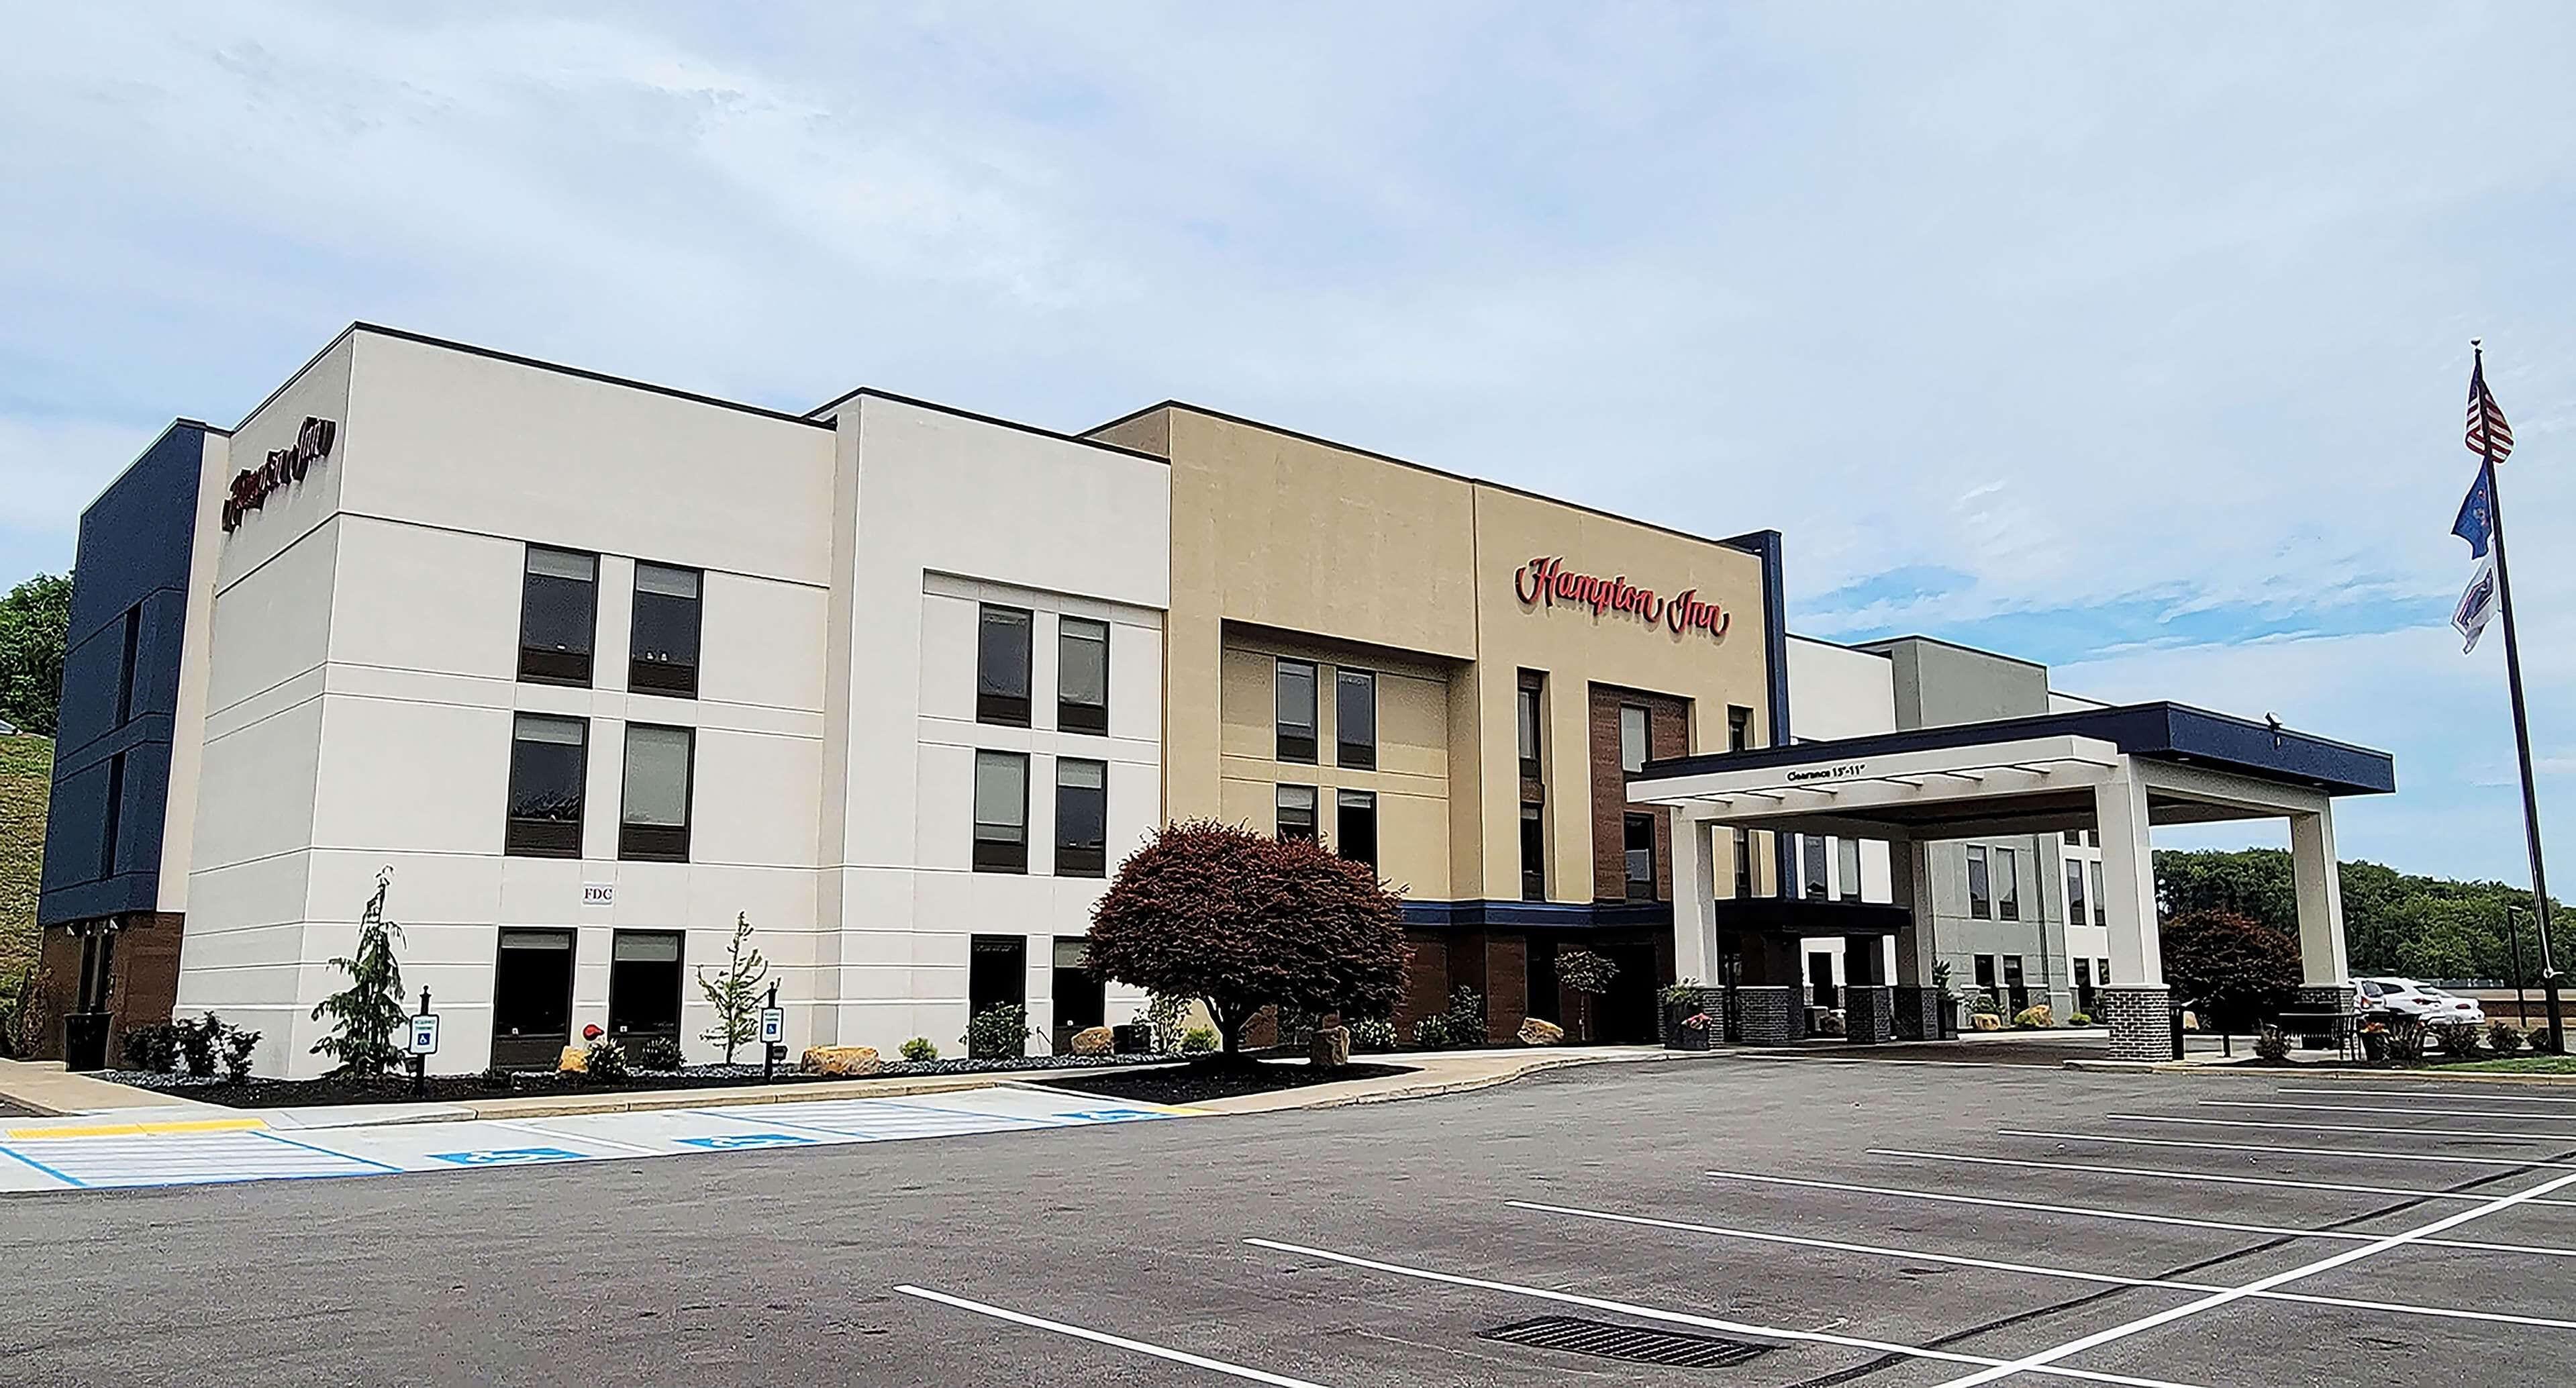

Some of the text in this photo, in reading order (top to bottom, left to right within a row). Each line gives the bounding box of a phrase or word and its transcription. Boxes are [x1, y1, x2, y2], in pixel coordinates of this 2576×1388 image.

[1515, 556, 1730, 637] Hampton Inn
[585, 888, 612, 900] FDC
